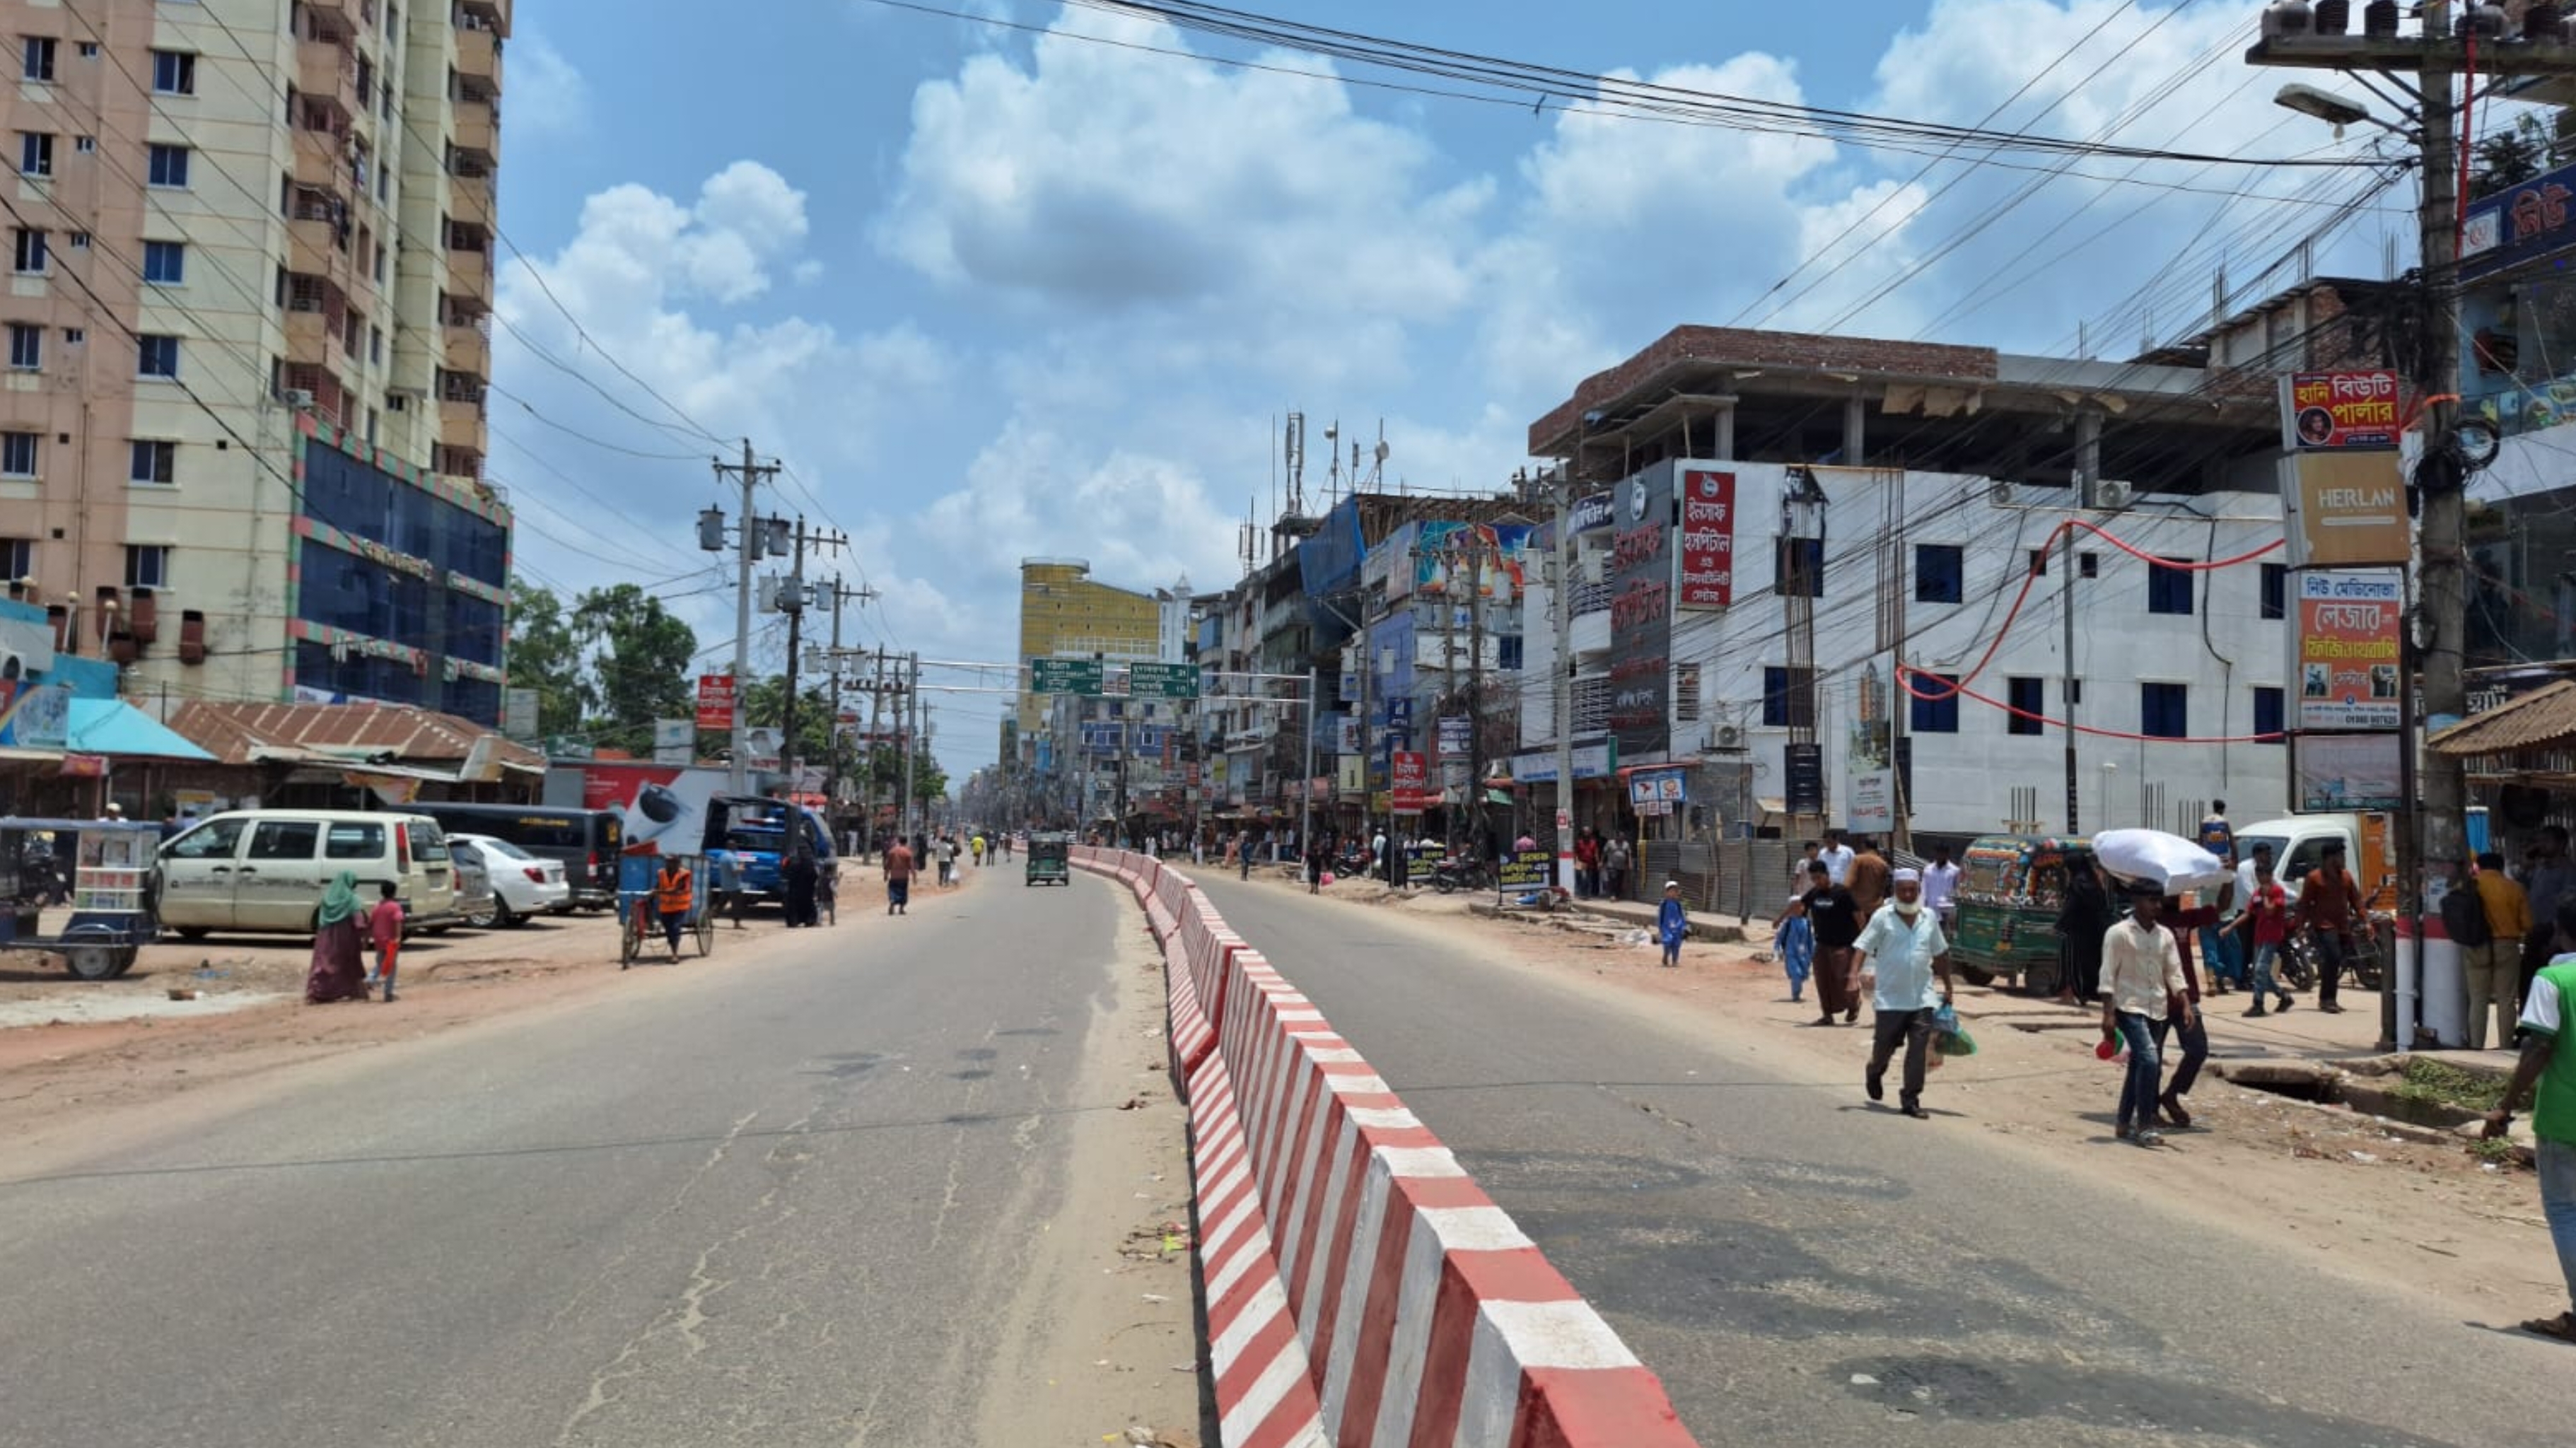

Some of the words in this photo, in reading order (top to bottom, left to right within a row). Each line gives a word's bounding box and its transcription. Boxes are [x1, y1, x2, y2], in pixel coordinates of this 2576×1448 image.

[2295, 381, 2329, 404] হানি
[2332, 373, 2394, 397] বিউটি
[2332, 396, 2395, 424] পার্লার
[2319, 487, 2395, 508] HERLAN
[2307, 576, 2330, 595] নিউ
[2315, 603, 2380, 636] লেজার
